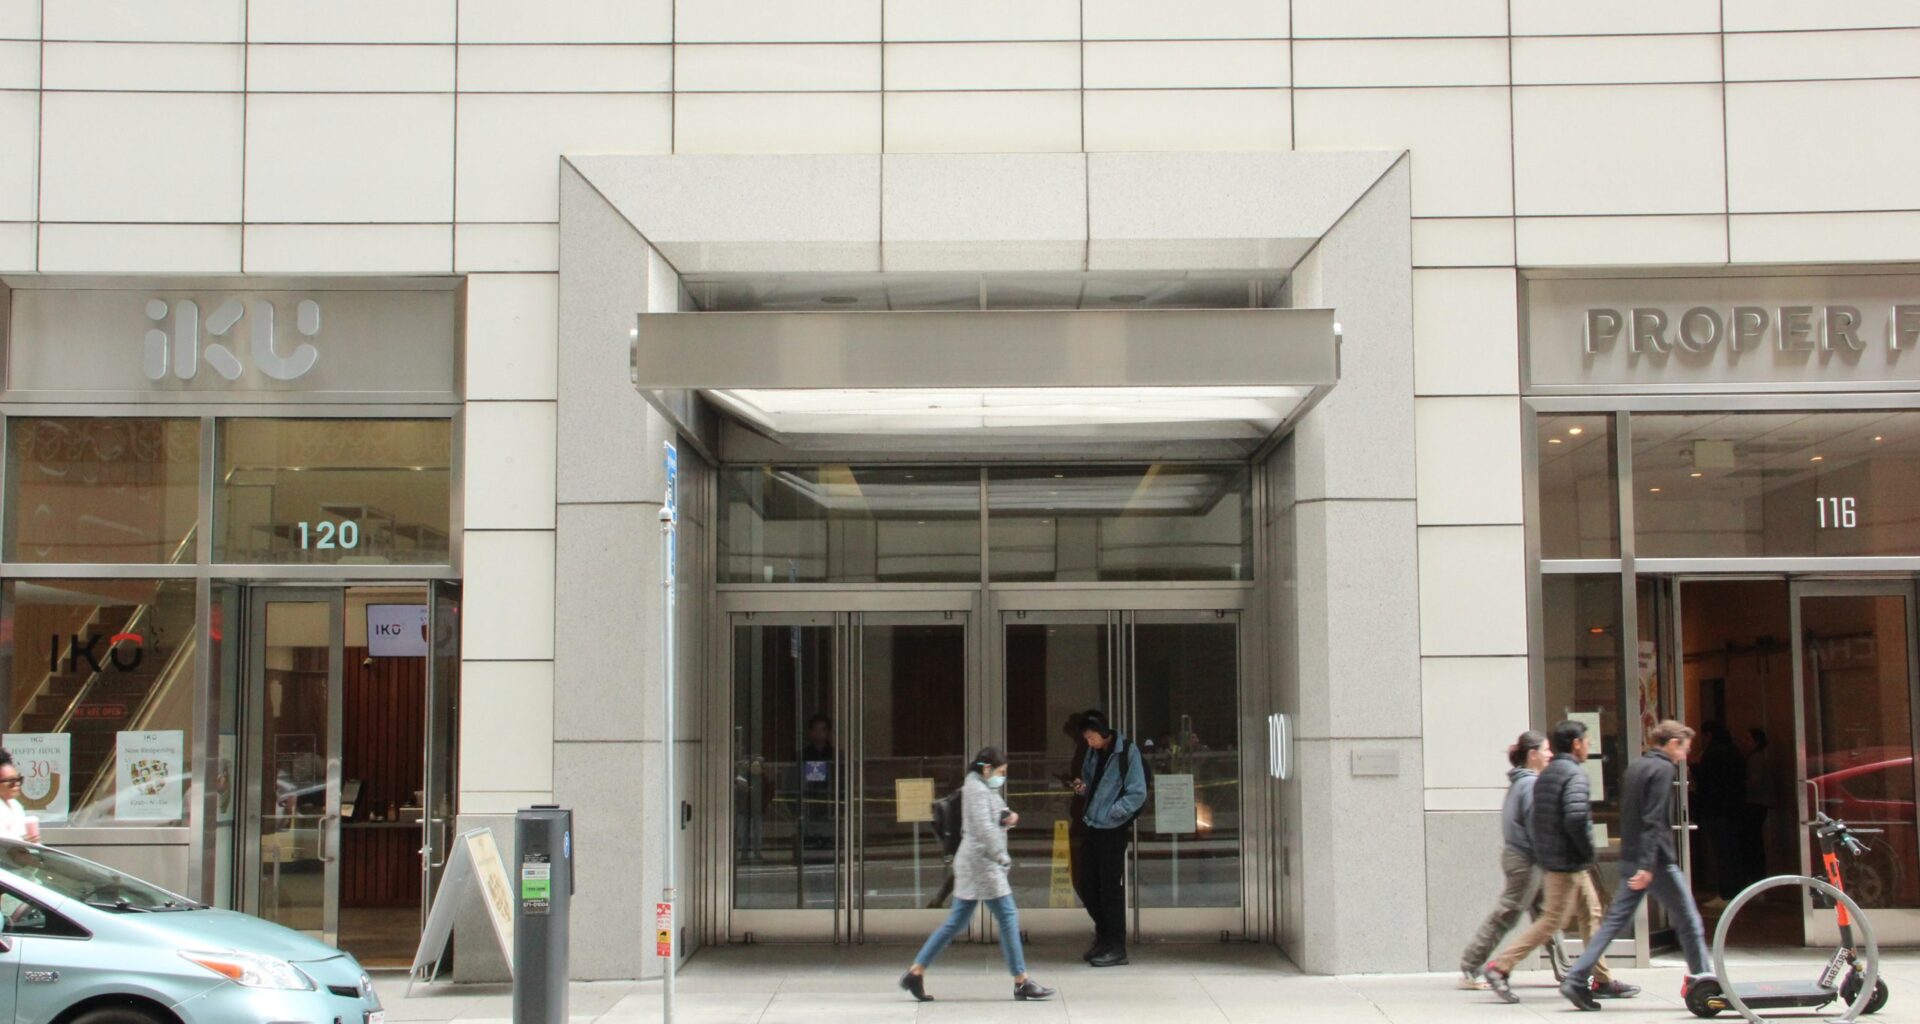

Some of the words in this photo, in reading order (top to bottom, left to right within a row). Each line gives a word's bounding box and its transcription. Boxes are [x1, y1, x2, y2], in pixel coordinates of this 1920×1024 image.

[1584, 304, 1867, 354] PROPER
[1816, 497, 1857, 529] 116
[298, 520, 359, 550] 120
[11, 747, 36, 755] HAPPY
[39, 747, 61, 755] HOUR
[1268, 713, 1286, 780] 100
[28, 760, 50, 778] 30
